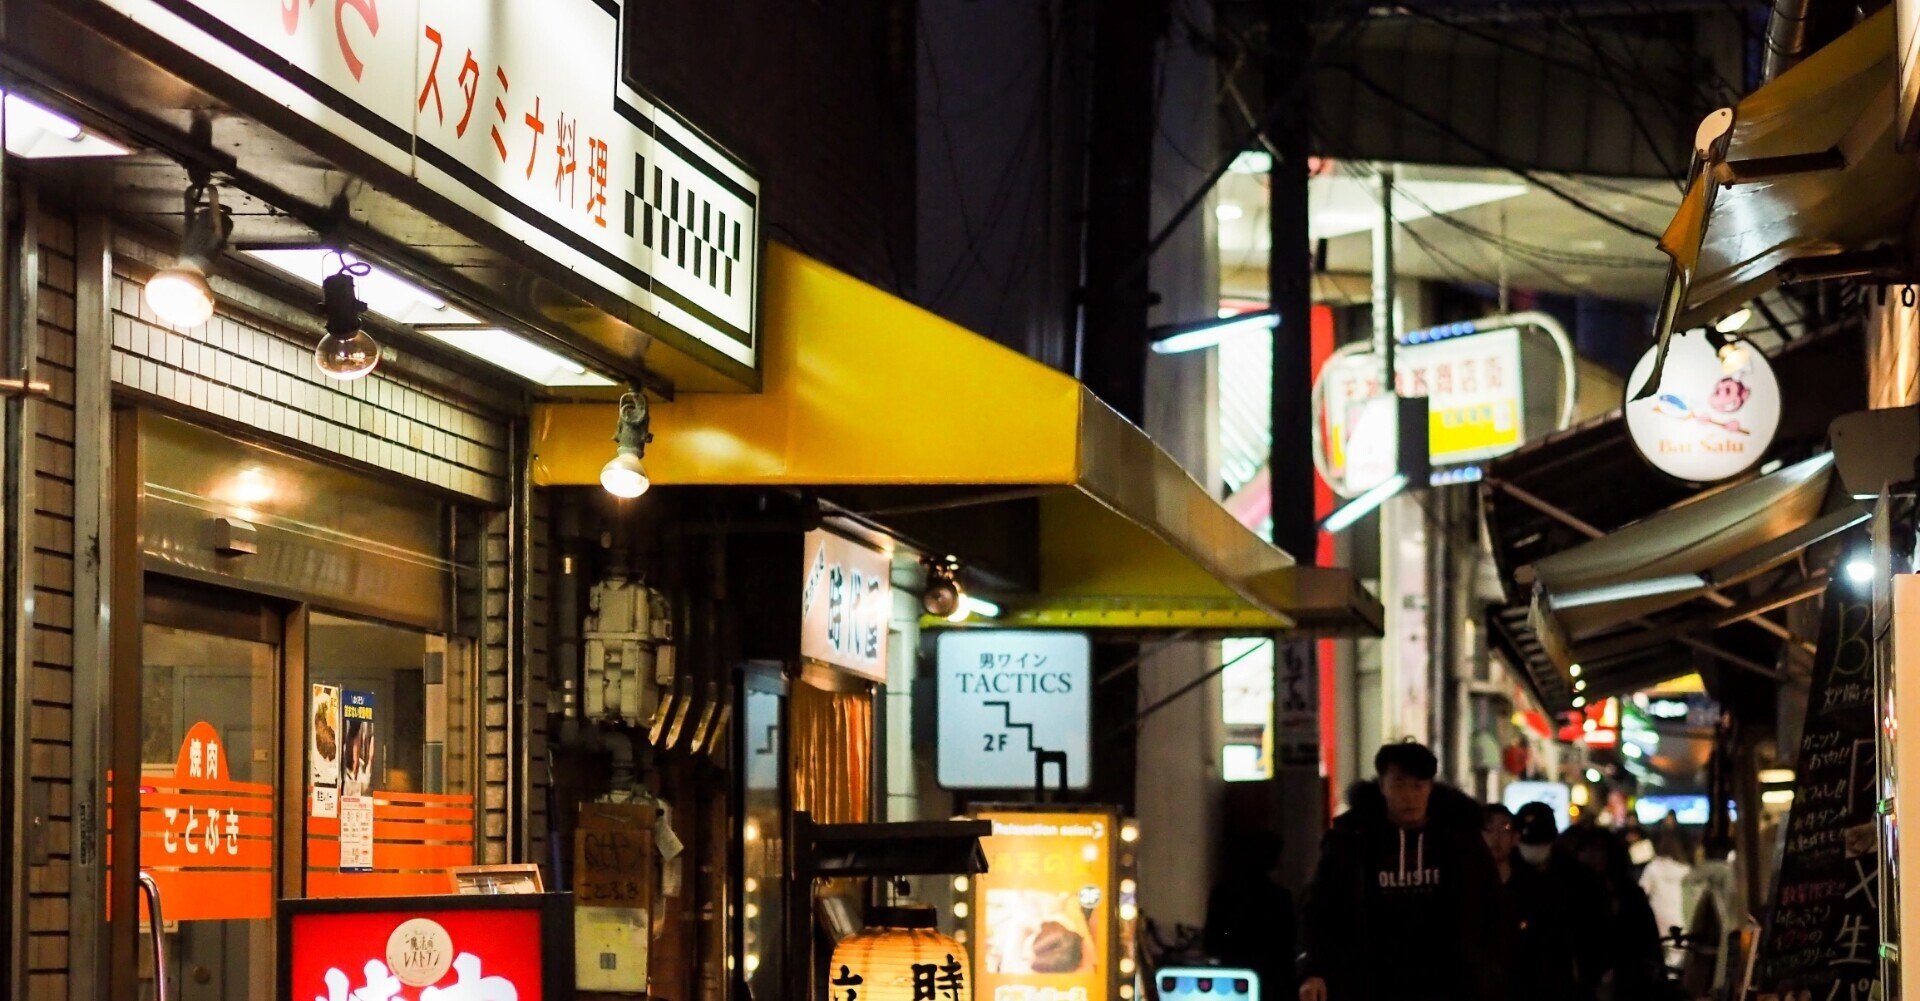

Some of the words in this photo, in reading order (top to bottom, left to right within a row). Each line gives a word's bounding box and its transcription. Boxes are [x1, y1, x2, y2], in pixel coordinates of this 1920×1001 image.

[418, 25, 608, 228] スタミナ料理
[1659, 439, 1693, 453] Bar
[979, 652, 1048, 669] 男ワイン
[955, 672, 1073, 694] TACTICS
[983, 733, 1008, 752] 2F
[189, 738, 218, 780] 焼肉
[165, 805, 239, 855] ことぶき
